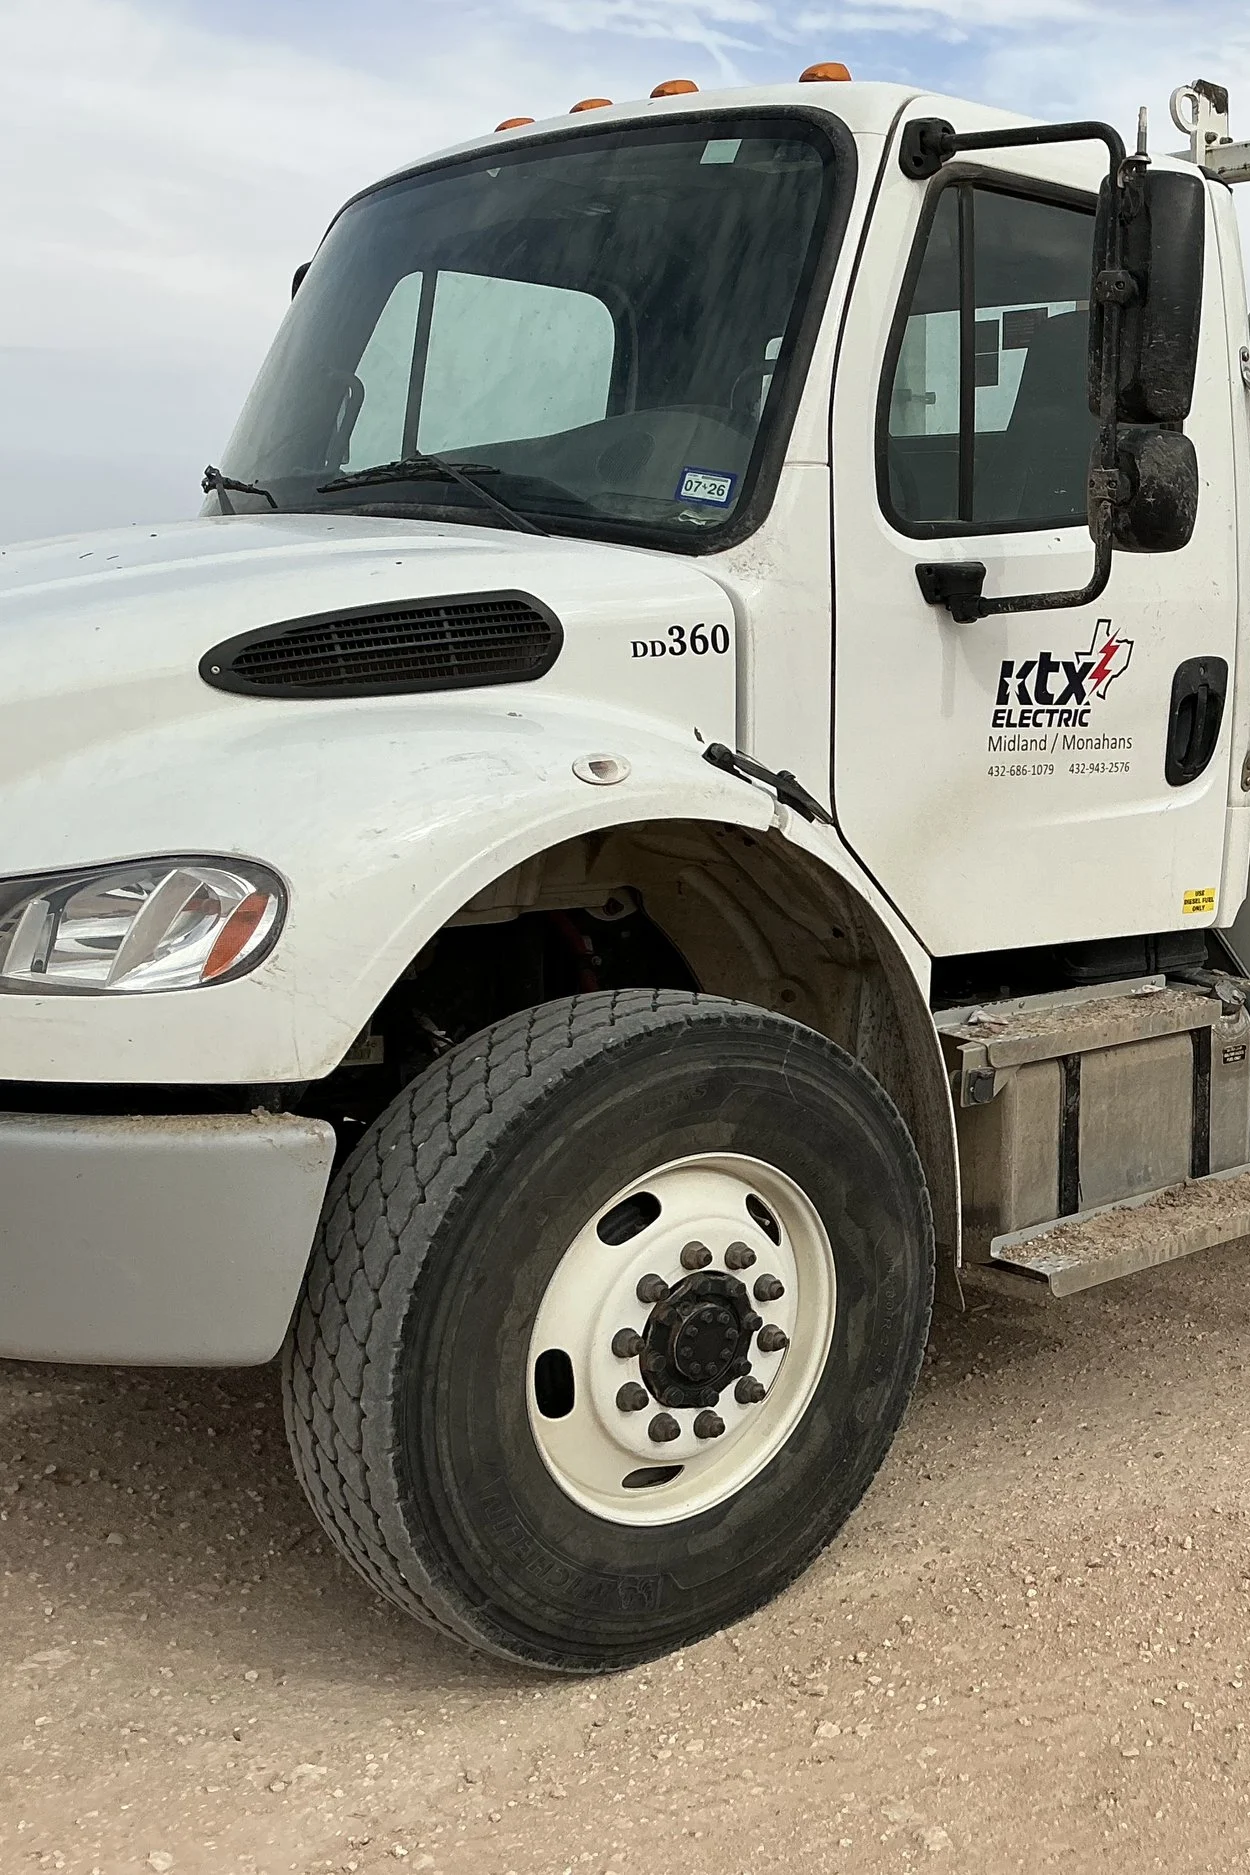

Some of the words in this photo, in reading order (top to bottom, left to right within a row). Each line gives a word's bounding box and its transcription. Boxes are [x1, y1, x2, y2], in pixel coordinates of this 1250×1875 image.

[684, 479, 703, 493] 07
[707, 483, 726, 497] 26
[630, 623, 730, 658] DD360
[991, 708, 1092, 728] ELECTRIC
[988, 733, 1048, 752] Midland
[1062, 733, 1133, 751] Monahans
[987, 763, 1055, 777] 432-686-1079
[1068, 761, 1130, 775] 432-943-2576
